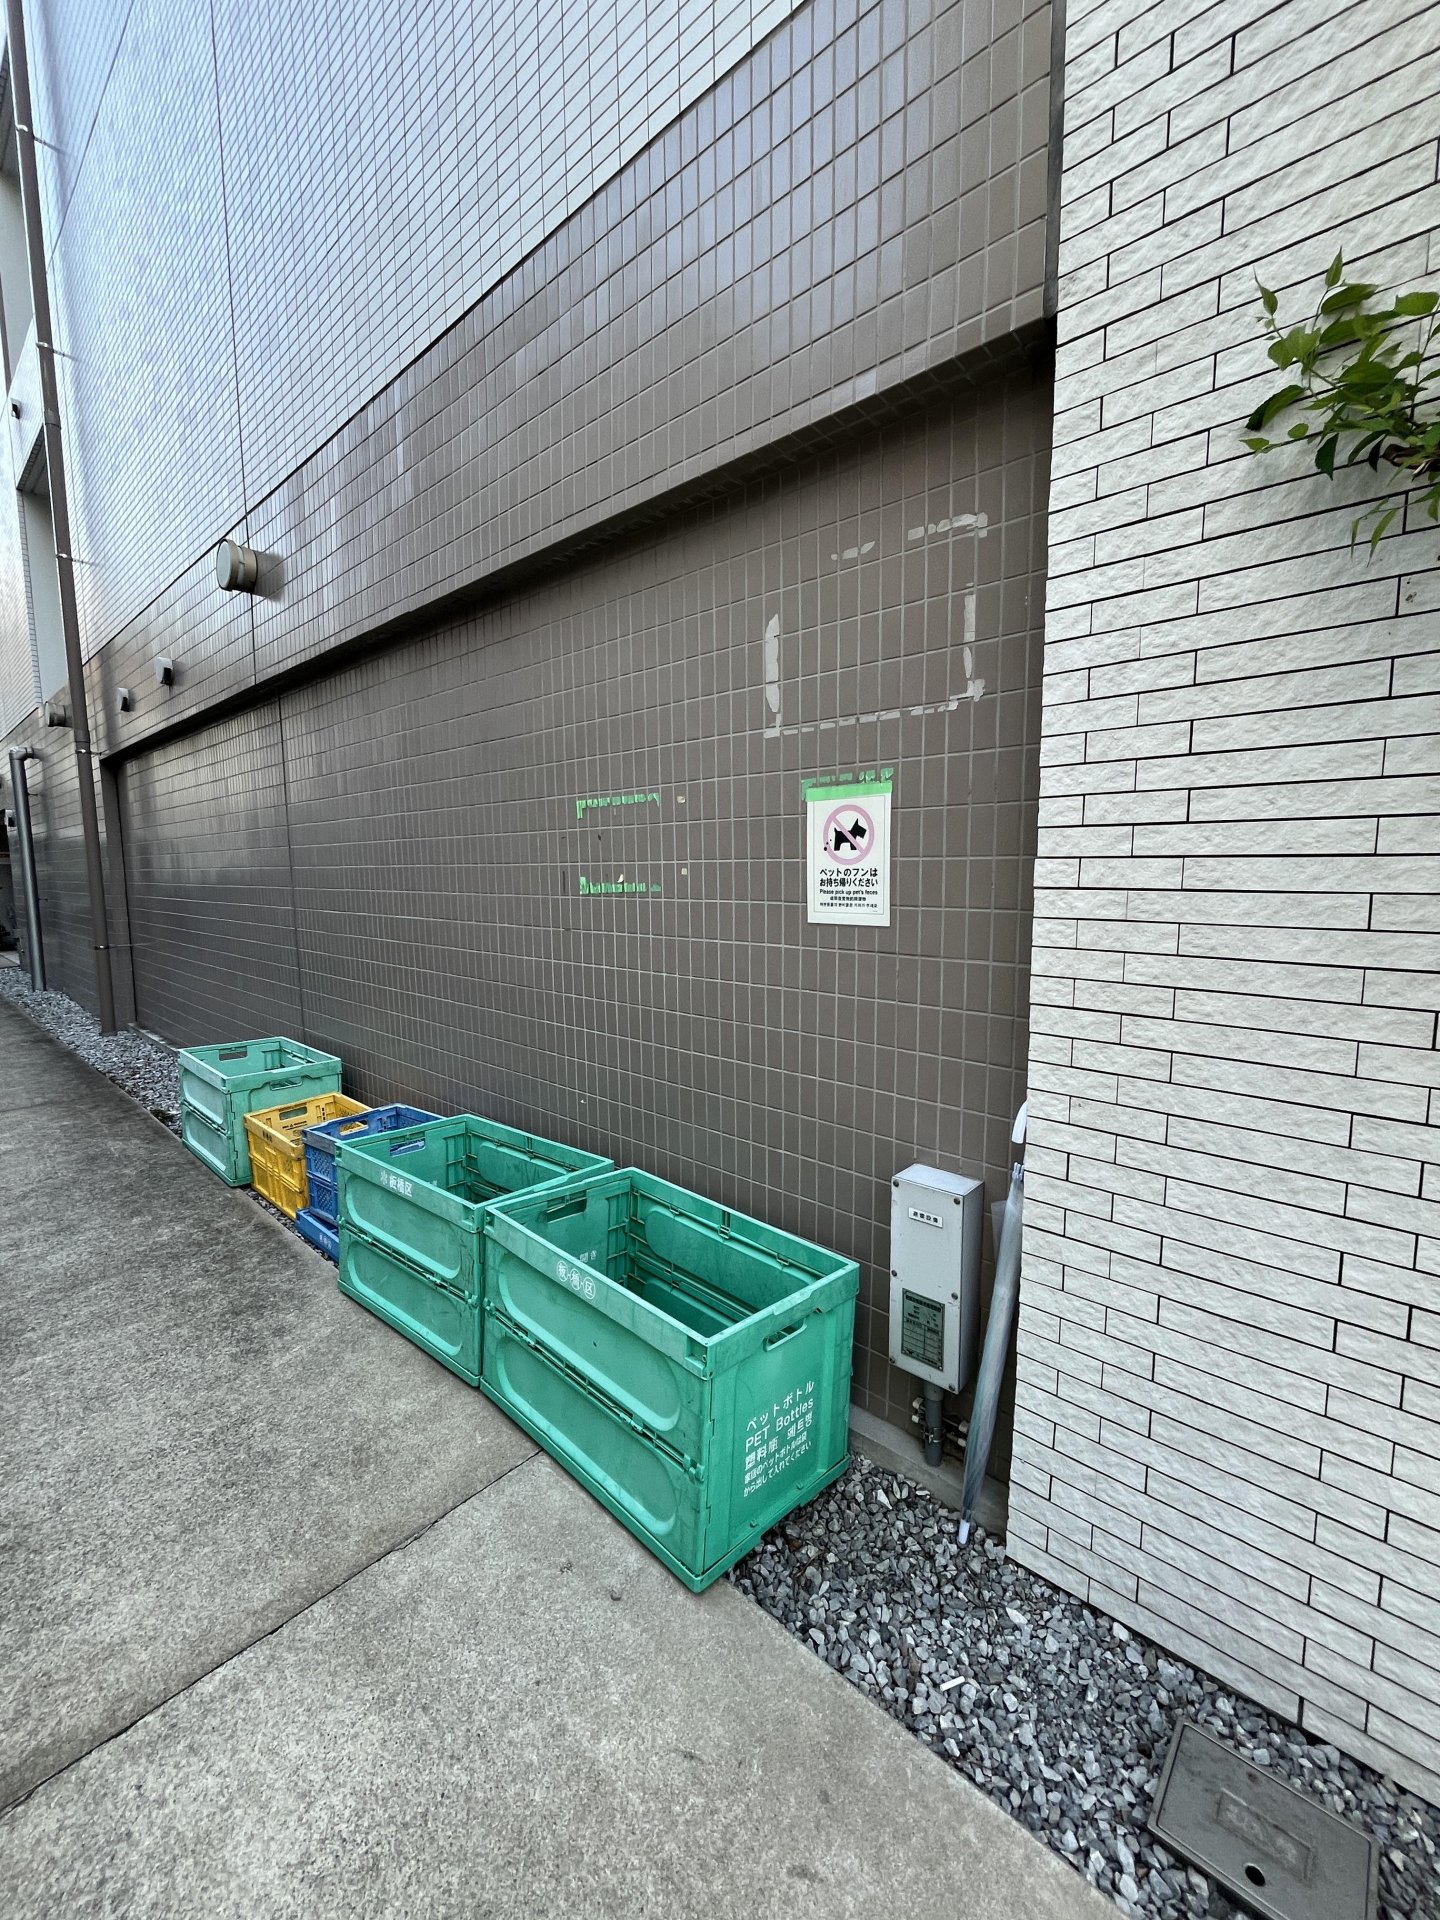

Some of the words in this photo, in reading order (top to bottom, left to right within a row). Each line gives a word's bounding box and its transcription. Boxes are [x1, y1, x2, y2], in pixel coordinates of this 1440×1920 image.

[819, 867, 878, 878] ペットのフンは
[819, 878, 878, 887] お持ち帰りください
[745, 1424, 771, 1453] PET
[776, 1398, 814, 1432] Bottles
[746, 1380, 814, 1431] ペットボトル
[743, 1441, 811, 1498] から出して入れてください
